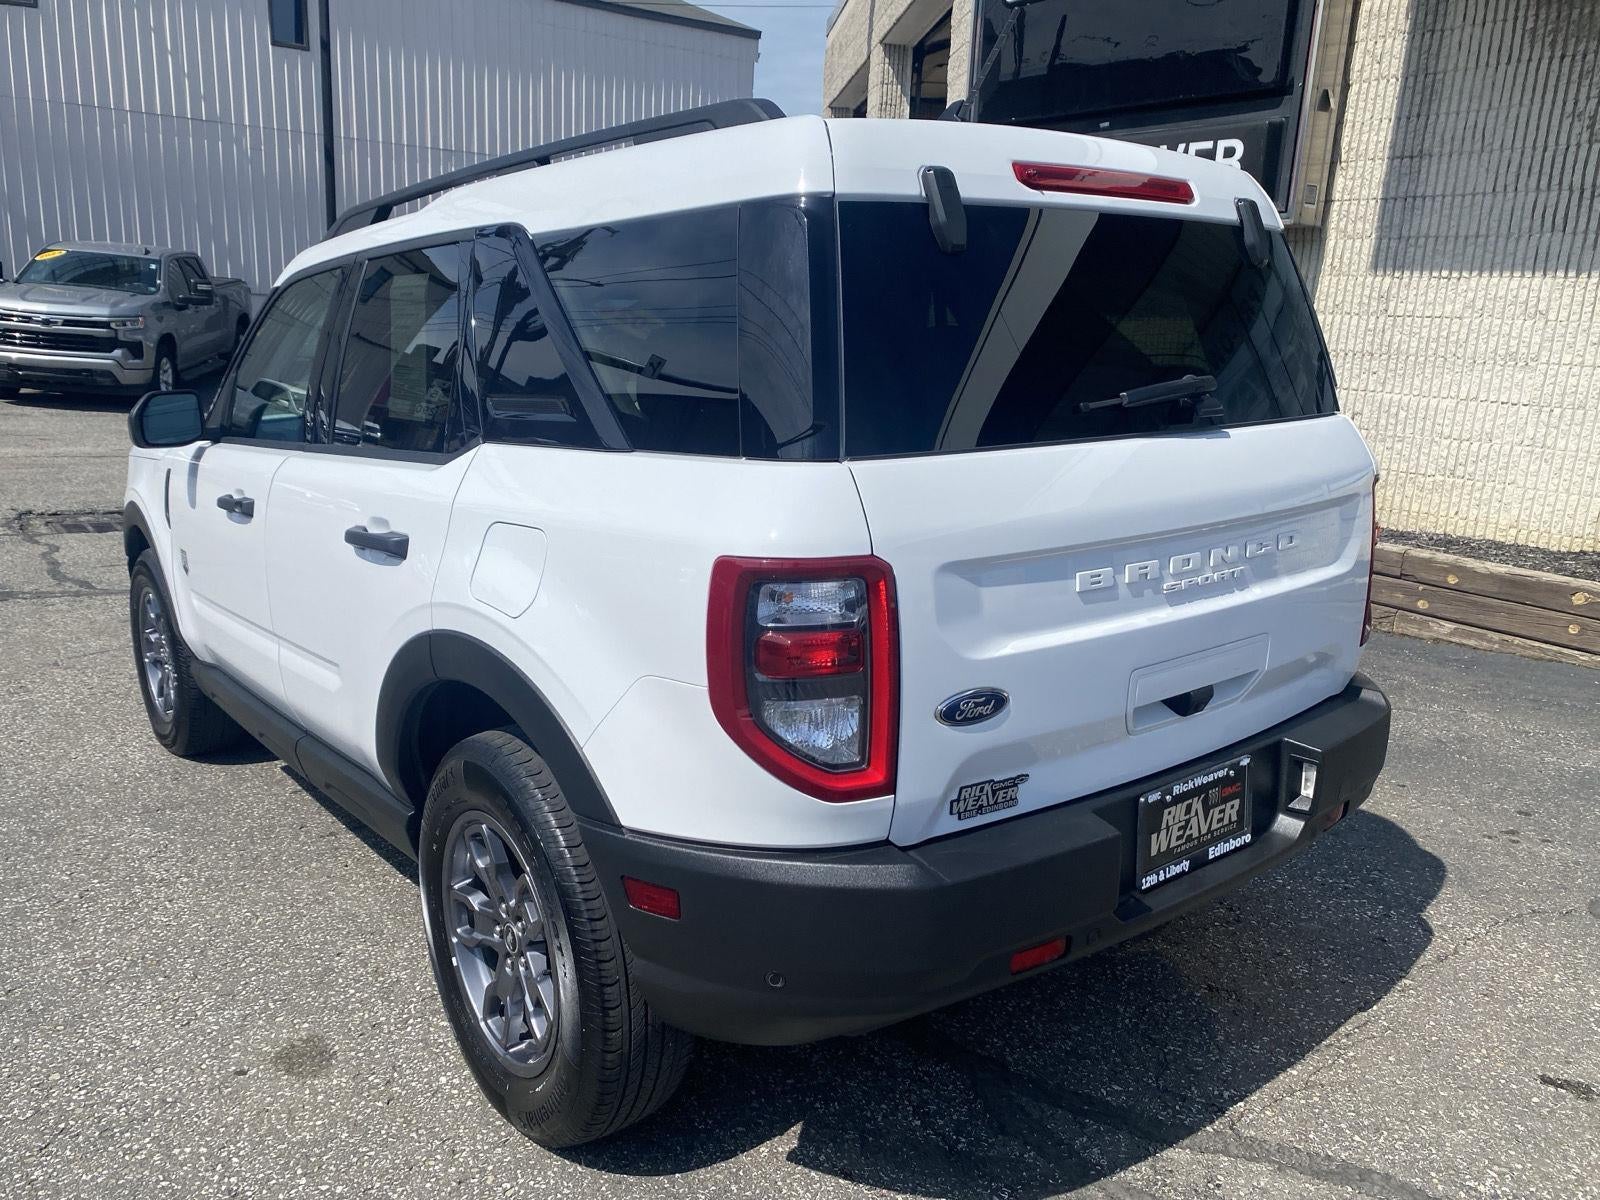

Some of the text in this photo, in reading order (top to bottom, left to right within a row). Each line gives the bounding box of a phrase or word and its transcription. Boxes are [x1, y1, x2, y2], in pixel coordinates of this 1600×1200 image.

[1075, 533, 1299, 593] BRONCO
[1162, 566, 1246, 595] SPORT
[955, 697, 995, 720] Ford
[960, 781, 994, 801] RICK
[992, 779, 1014, 790] GMC
[1172, 767, 1229, 797] RickWeaver
[1221, 783, 1242, 797] GMC
[952, 786, 1018, 815] WEAVER
[960, 799, 1018, 820] ERIE EDINBORO
[1160, 794, 1206, 830] RICK
[1150, 798, 1240, 857] WEAVER
[1173, 822, 1237, 855] FAMOUS FOR SERVICE
[1208, 833, 1252, 860] Edinboro
[1141, 859, 1190, 890] 12th & Liberty
